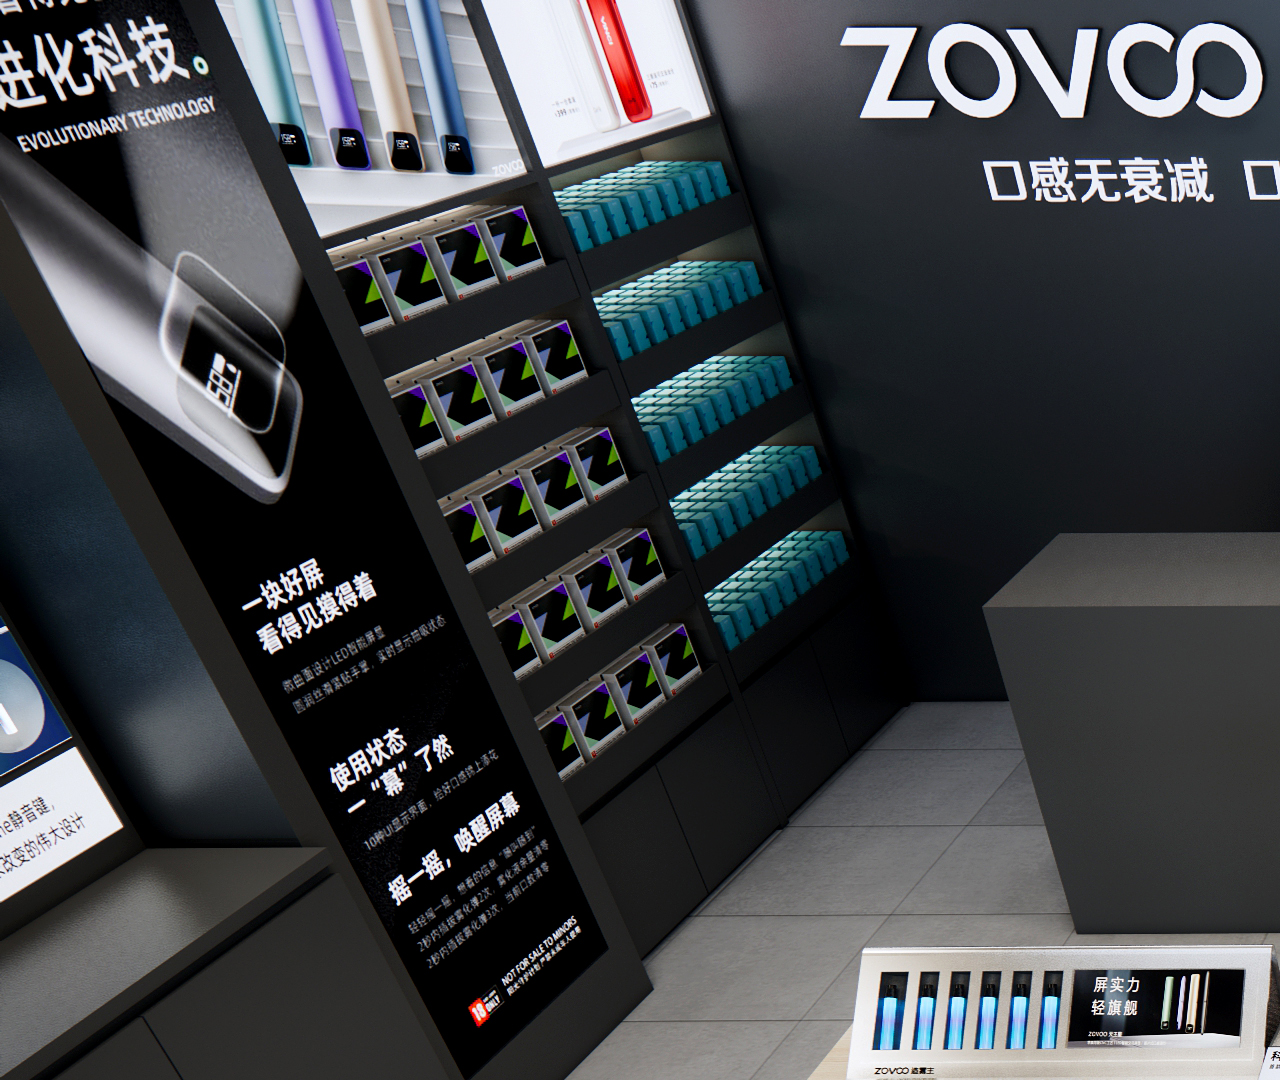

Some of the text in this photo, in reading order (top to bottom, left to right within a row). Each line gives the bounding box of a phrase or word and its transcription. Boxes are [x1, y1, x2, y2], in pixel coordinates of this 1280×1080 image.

[0, 16, 209, 111] 进化科技。
[840, 22, 1264, 119] ZOVOO
[17, 95, 217, 153] EVOLUTIONARY TECHNOLOGY
[491, 158, 525, 178] ZOVOO
[981, 156, 1215, 204] 口感无衰减
[241, 557, 325, 611] 一块好屏
[256, 571, 377, 655] 看得见摸得着
[329, 727, 408, 793] 使用状态
[501, 915, 578, 987] NOT FOR SALE TO MINORS
[1090, 999, 1139, 1017] 轻旗舰
[1093, 976, 1141, 993] 屏实力
[471, 1002, 487, 1022] 18
[873, 1067, 909, 1075] ZOVOO
